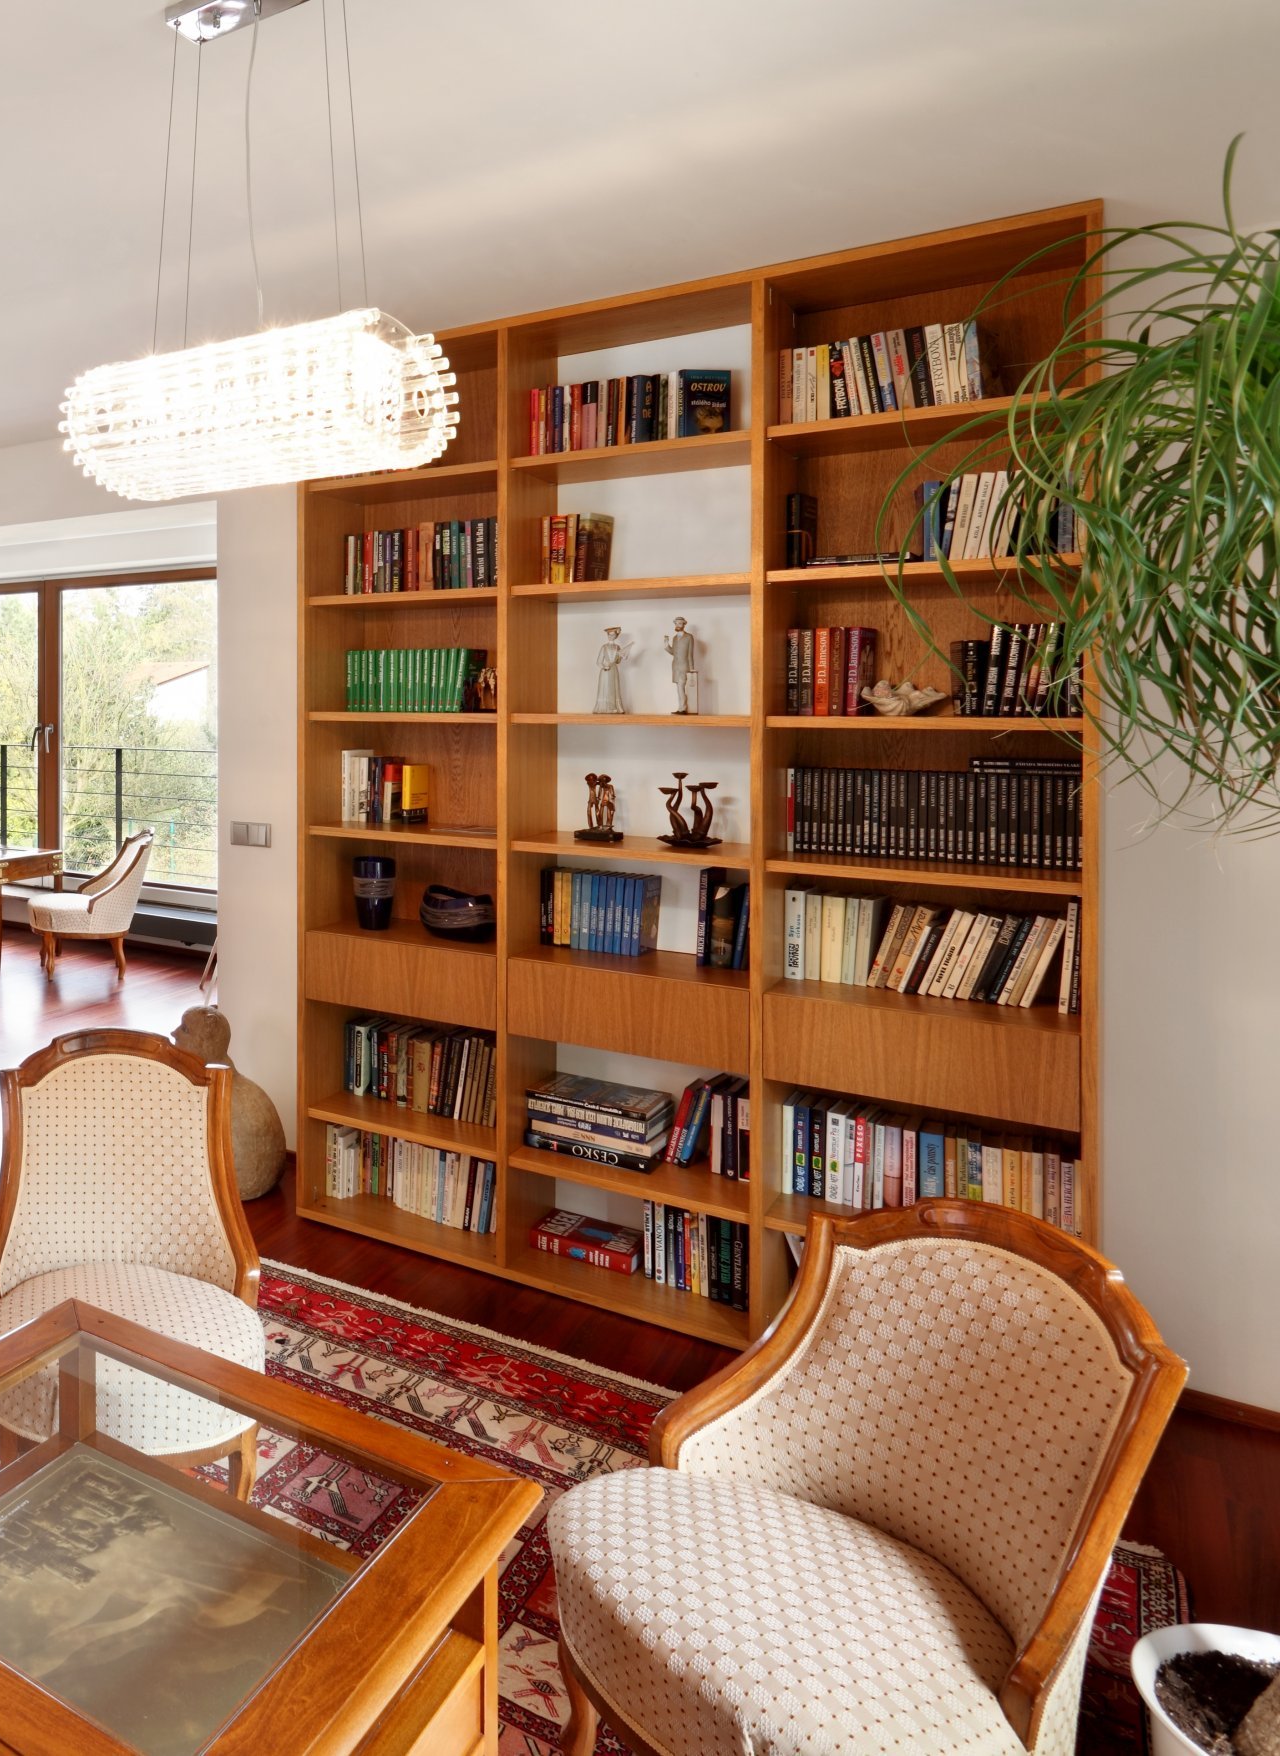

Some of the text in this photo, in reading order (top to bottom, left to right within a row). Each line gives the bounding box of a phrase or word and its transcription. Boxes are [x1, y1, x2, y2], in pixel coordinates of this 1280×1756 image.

[817, 631, 828, 668] Jamesová
[935, 946, 956, 983] PAVEL TIGRID
[669, 1126, 681, 1151] CARNEGIE
[855, 1124, 864, 1159] PEXESO
[926, 1143, 940, 1165] pomsty
[1063, 1205, 1073, 1216] IVA
[655, 1222, 663, 1252] IVANOV
[732, 1239, 743, 1291] GENTLEMAN
